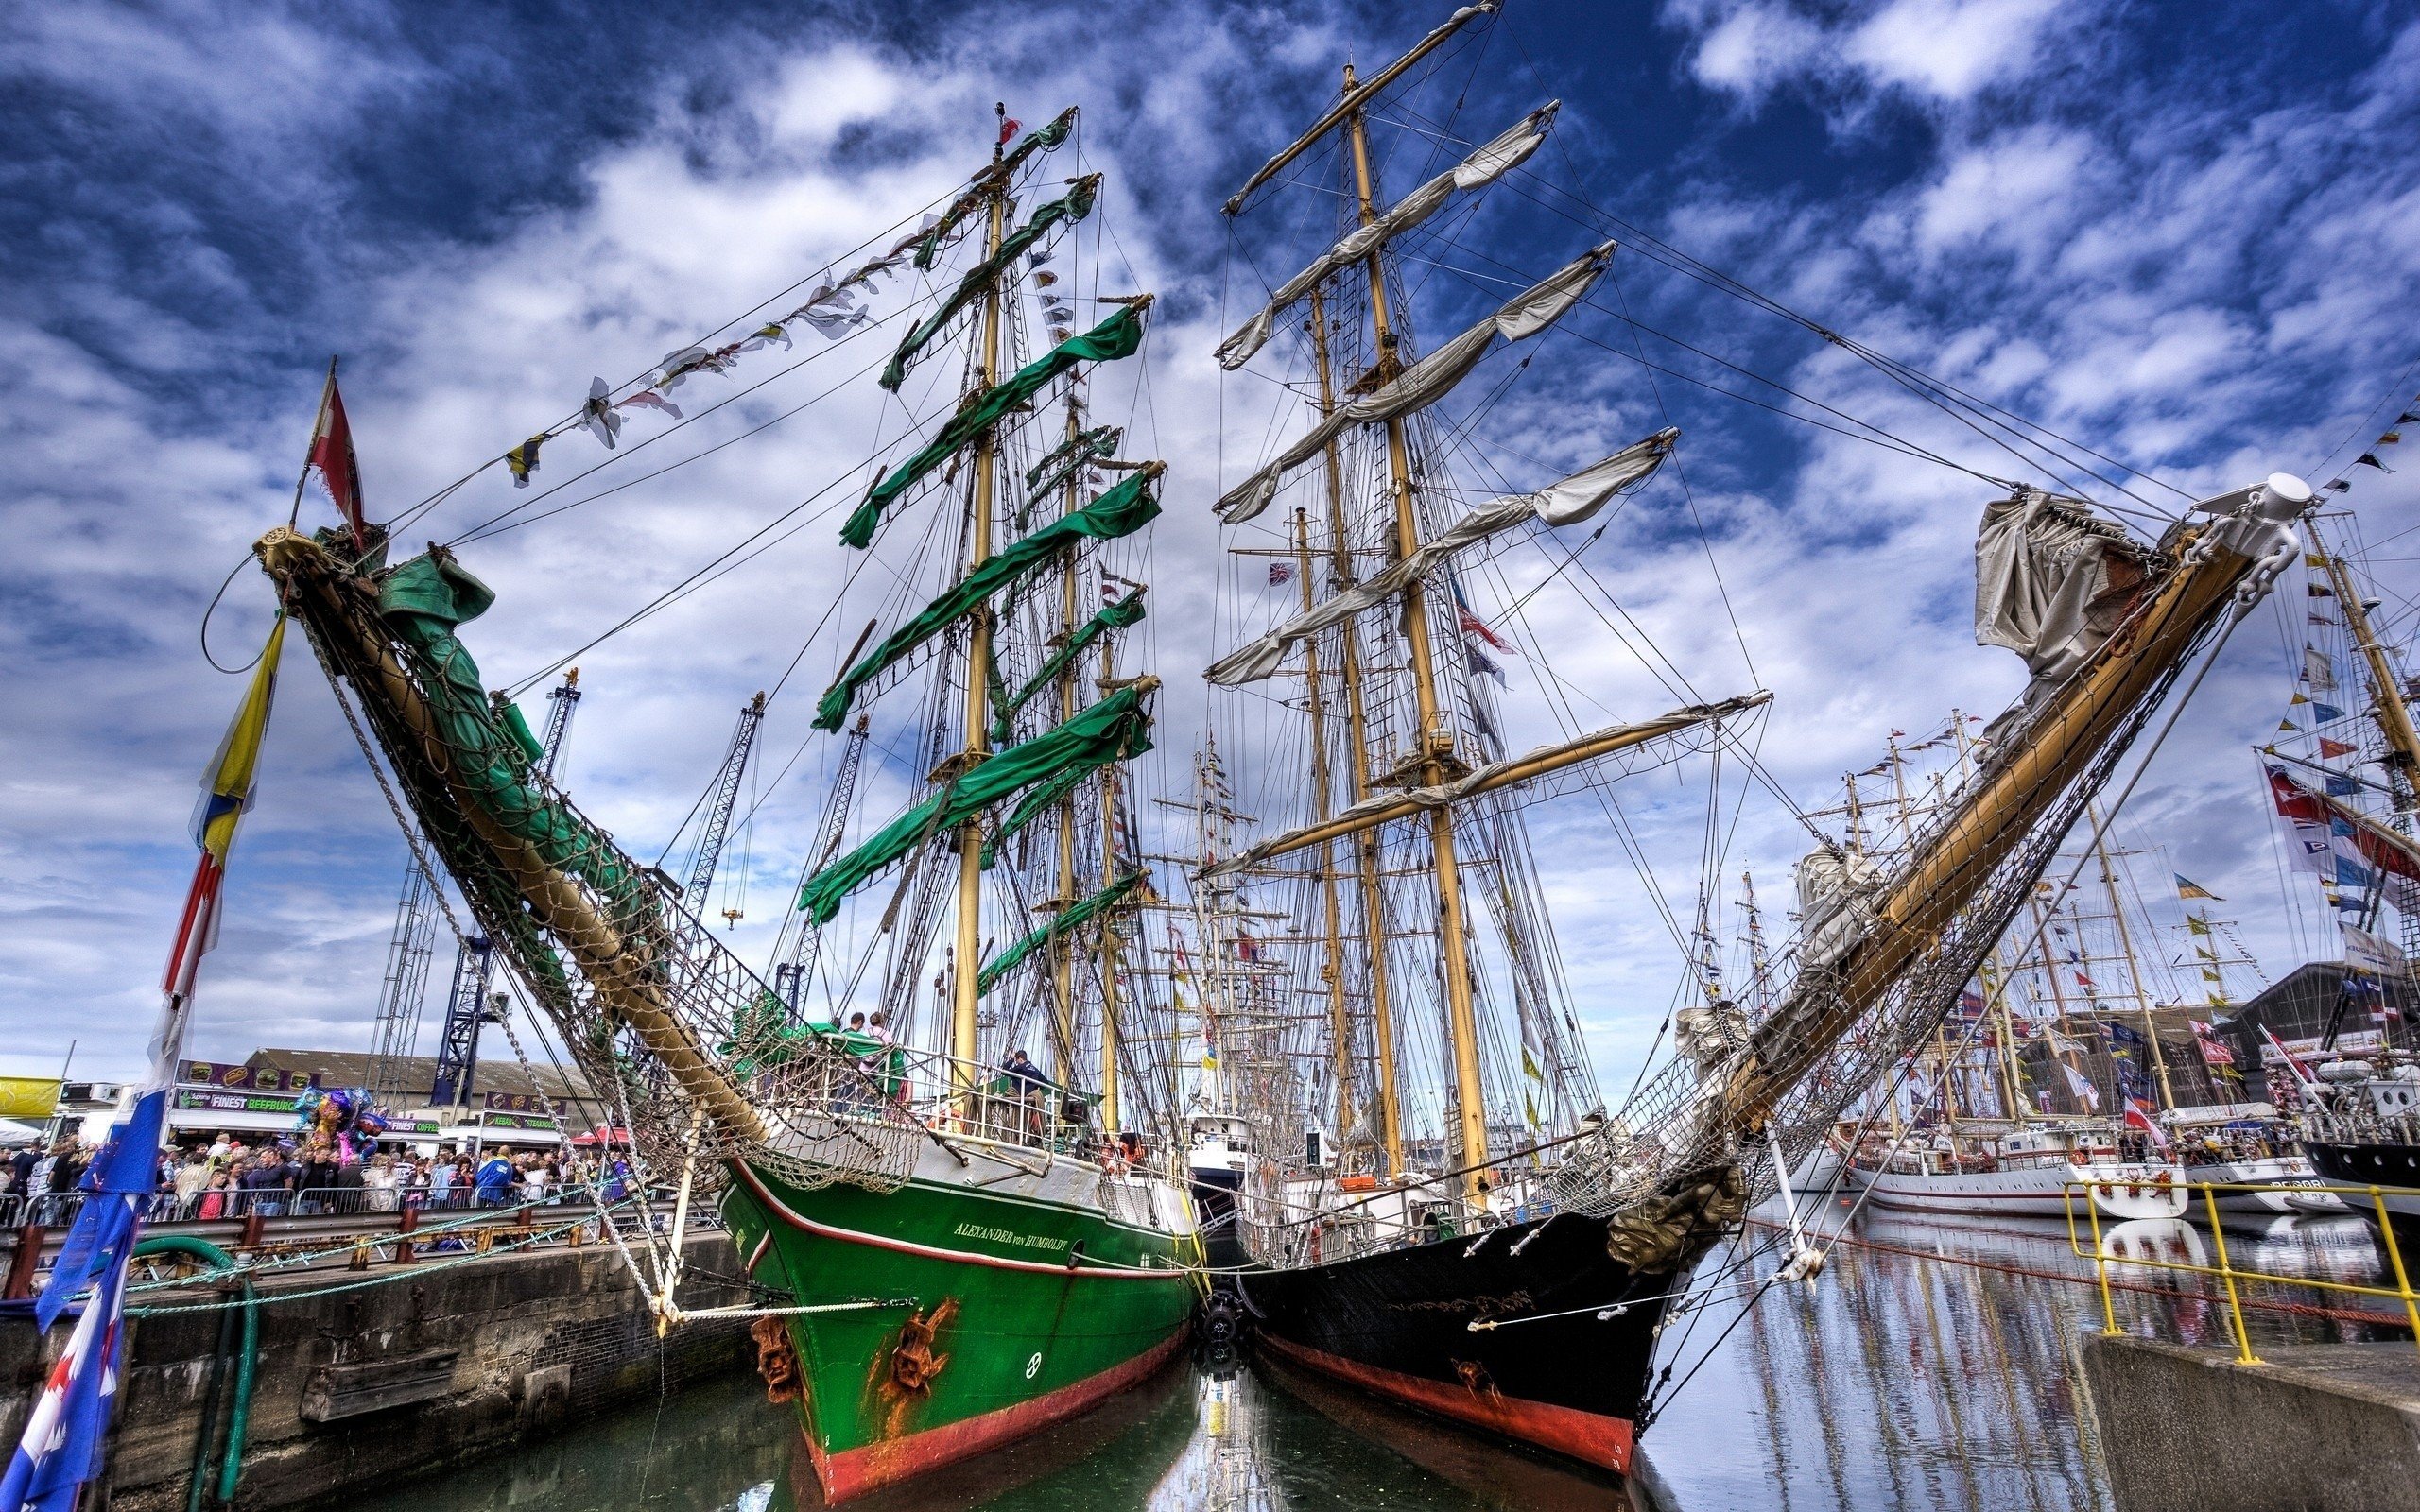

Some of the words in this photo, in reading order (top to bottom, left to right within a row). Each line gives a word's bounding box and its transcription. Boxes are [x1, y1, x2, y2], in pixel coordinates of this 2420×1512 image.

[212, 1095, 248, 1108] FINEST
[494, 1116, 512, 1126] KEBAB
[527, 1119, 558, 1129] STEAKHOUS
[392, 1122, 415, 1131] FINEST
[954, 1222, 1013, 1244] ALEXANDER
[1025, 1234, 1068, 1251] HUMBOLDT
